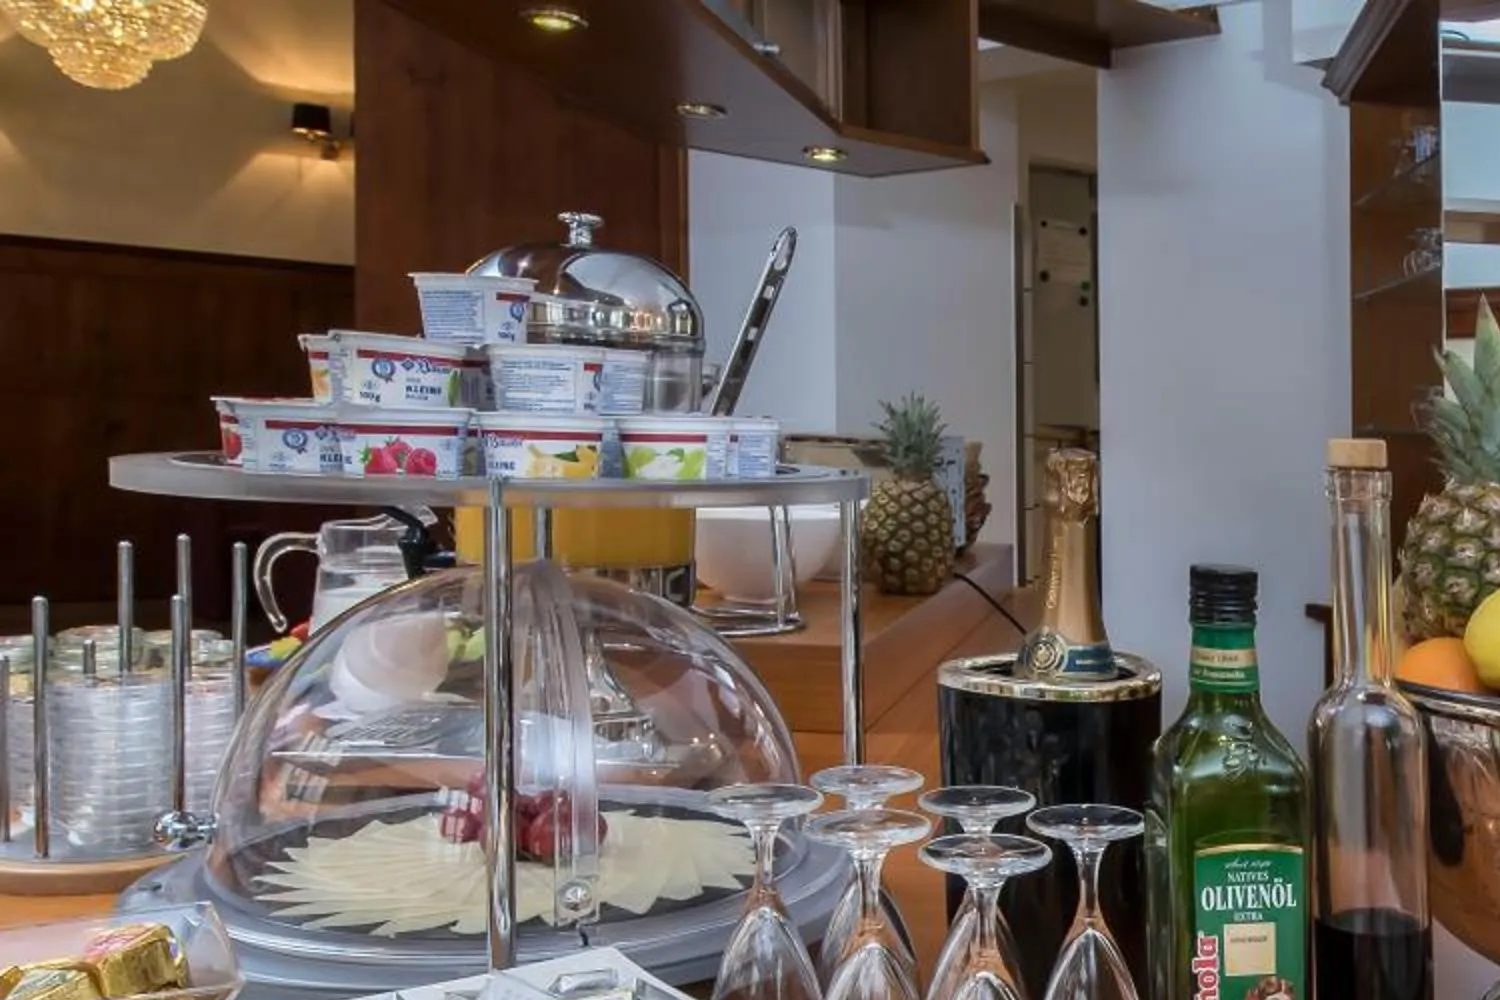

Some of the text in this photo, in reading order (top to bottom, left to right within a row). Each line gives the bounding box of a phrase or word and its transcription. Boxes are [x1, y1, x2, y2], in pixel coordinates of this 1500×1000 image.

[1227, 870, 1269, 883] NATIVES
[1201, 877, 1297, 911] OLIVENÖL
[1233, 911, 1263, 921] EXTRA
